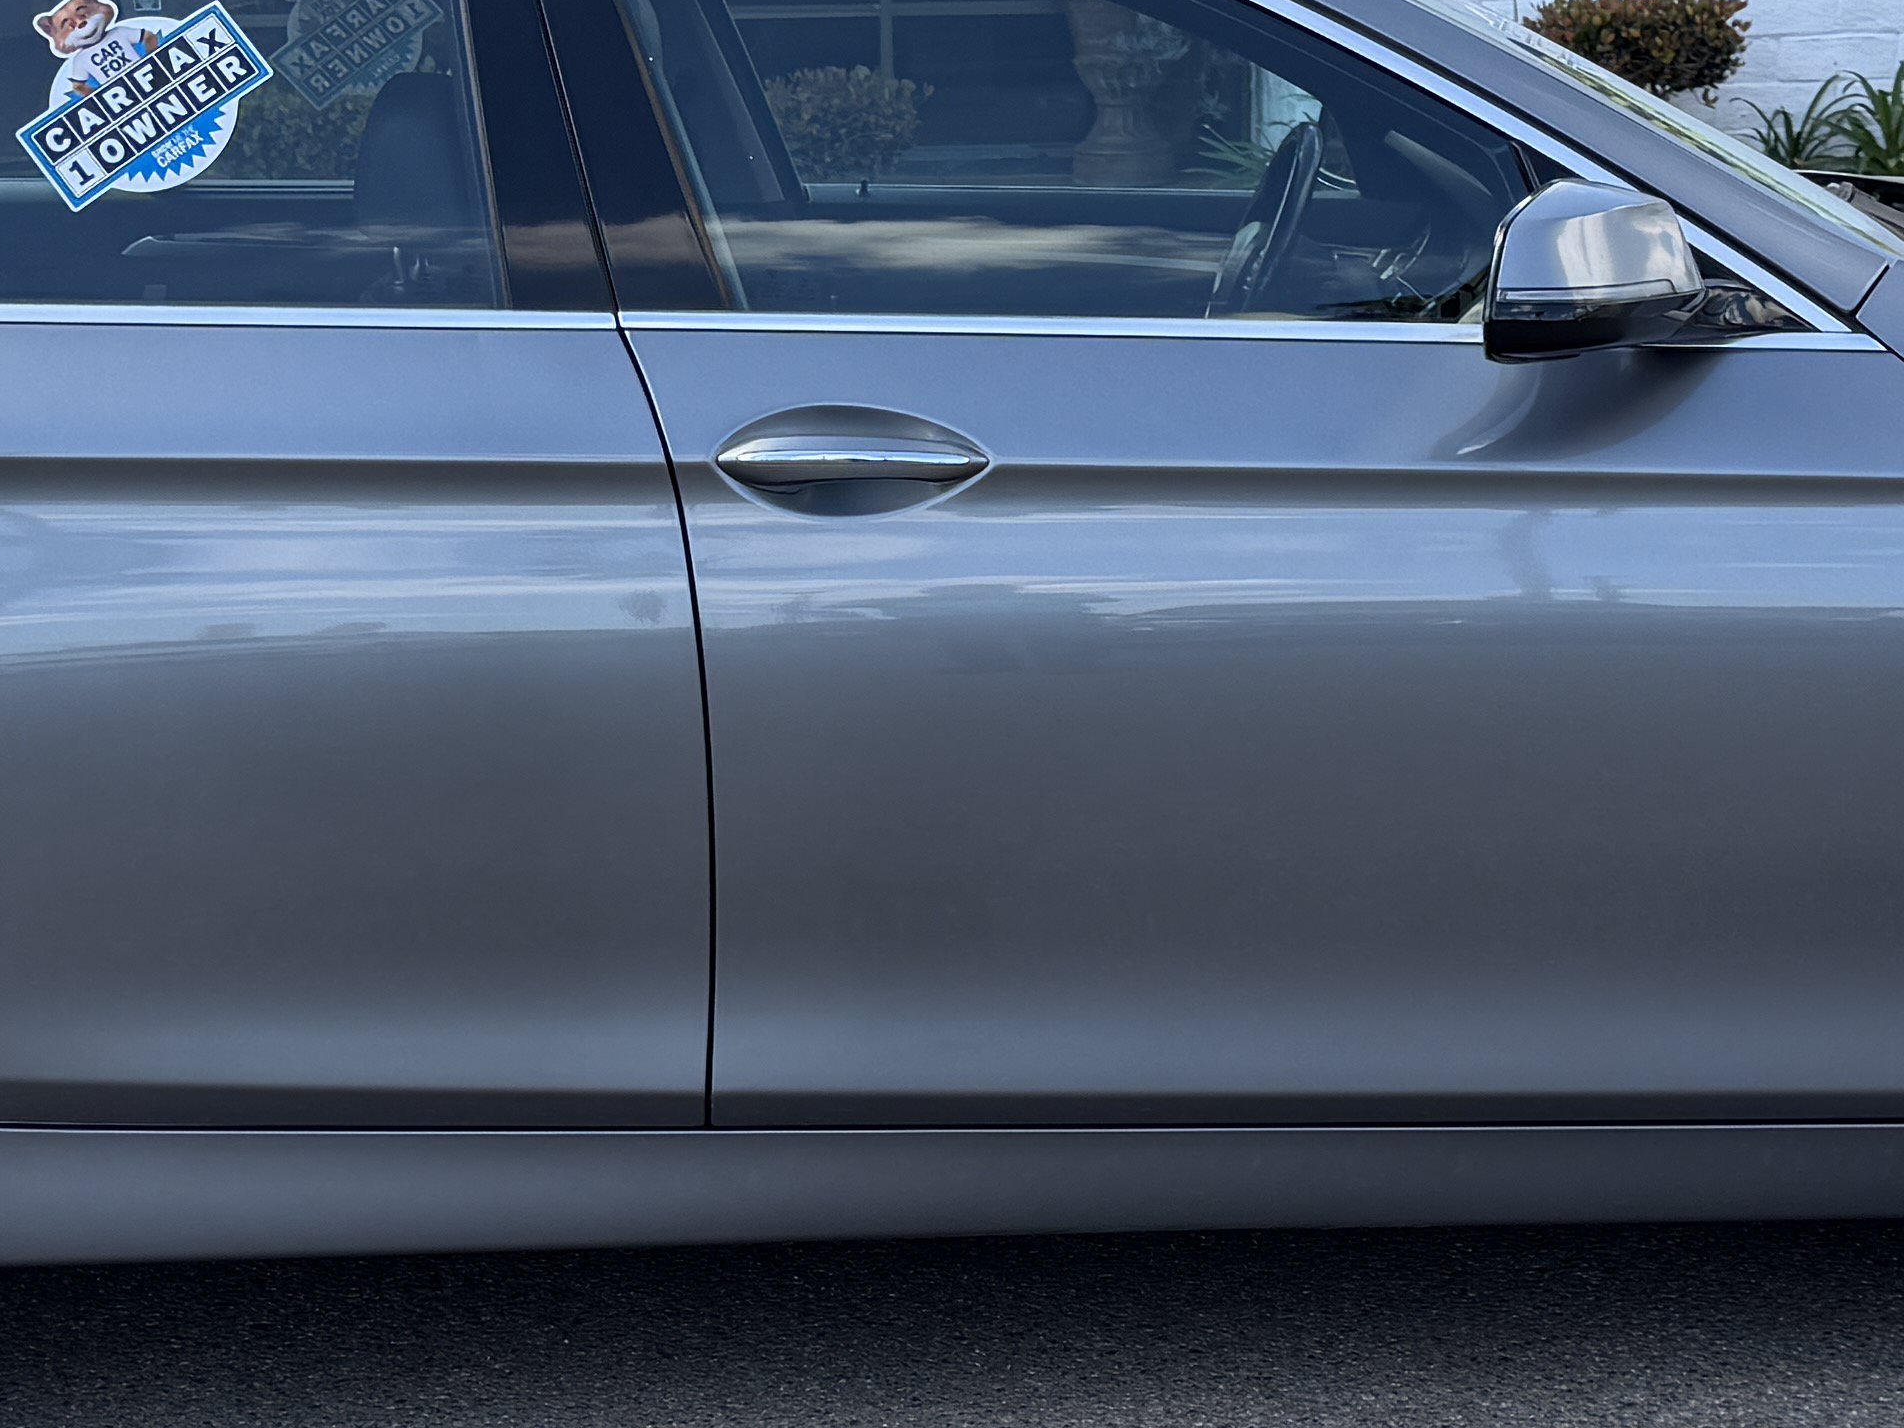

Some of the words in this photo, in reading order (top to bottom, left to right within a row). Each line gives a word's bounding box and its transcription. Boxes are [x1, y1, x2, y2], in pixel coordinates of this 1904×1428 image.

[91, 40, 123, 66] CAR
[100, 52, 132, 78] FOX
[46, 28, 226, 153] CARFAX
[68, 159, 94, 186] 1
[99, 54, 247, 164] OWNER
[157, 130, 204, 168] CARFAX
